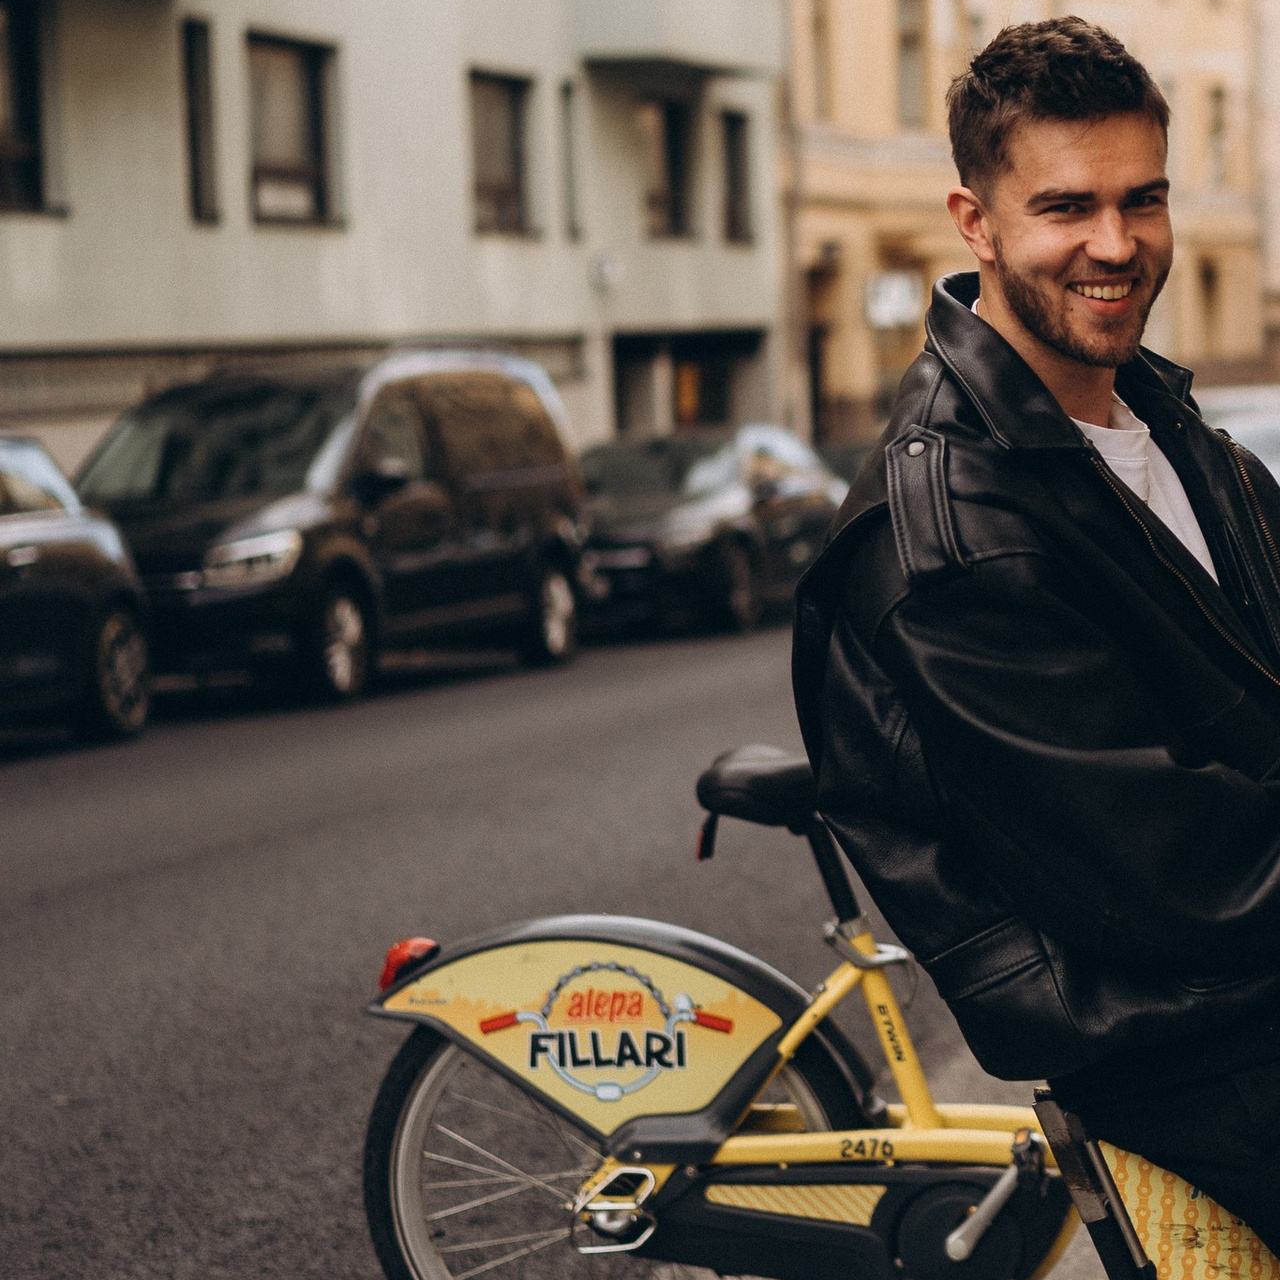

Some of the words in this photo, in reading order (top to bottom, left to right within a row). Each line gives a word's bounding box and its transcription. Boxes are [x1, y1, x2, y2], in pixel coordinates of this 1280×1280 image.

[567, 987, 643, 1022] alepa
[529, 1029, 687, 1069] FILLARI
[840, 1137, 894, 1158] 2476
